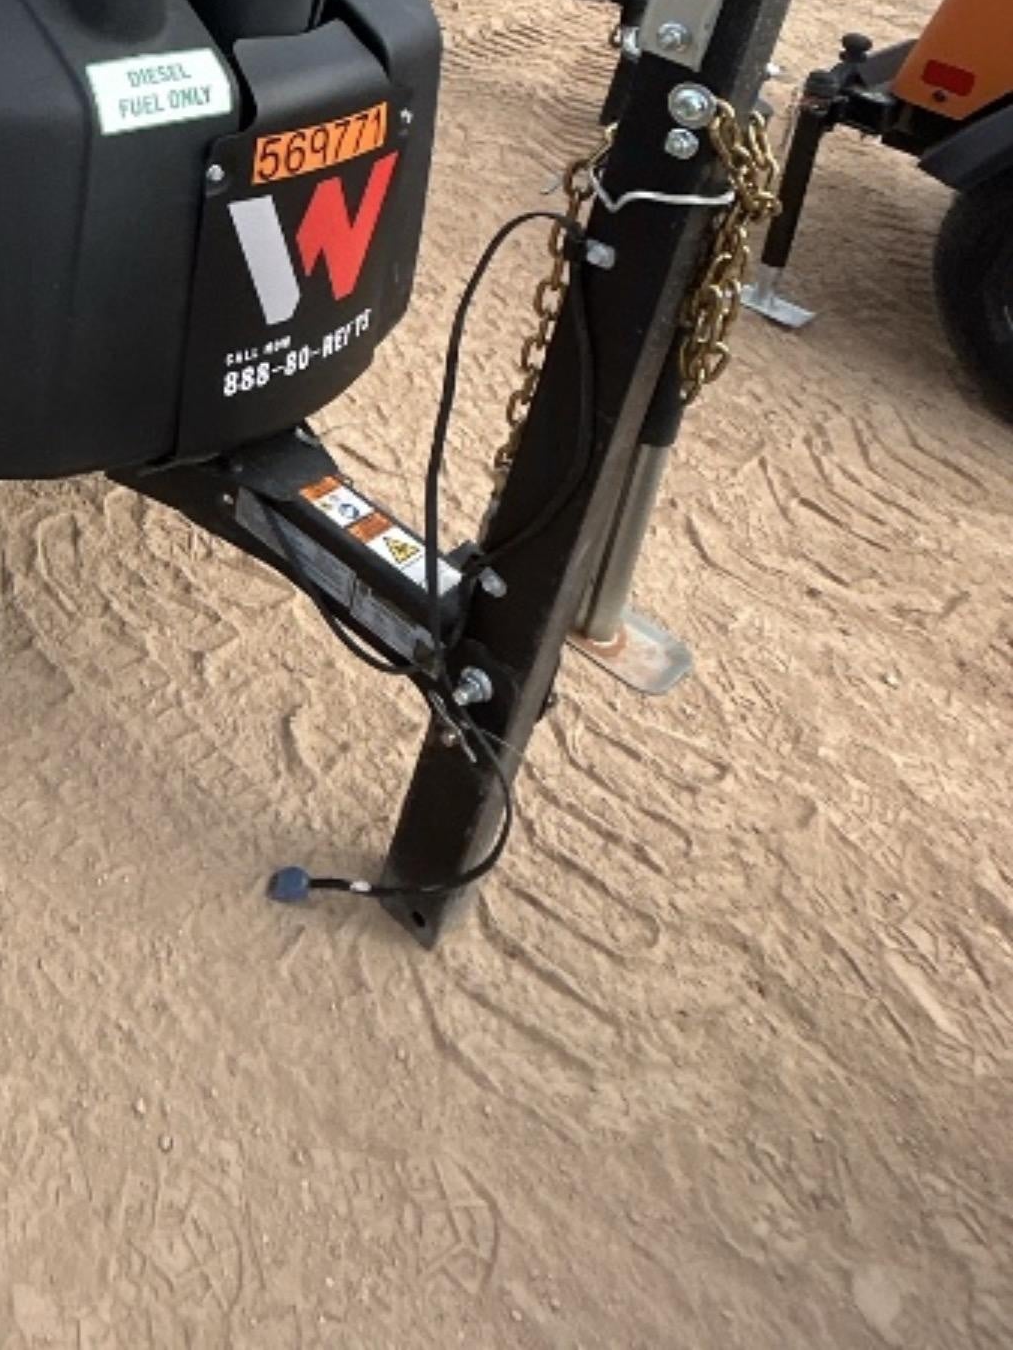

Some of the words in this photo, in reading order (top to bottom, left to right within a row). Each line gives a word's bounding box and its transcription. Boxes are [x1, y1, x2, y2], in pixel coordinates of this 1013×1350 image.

[126, 62, 193, 88] DIESEL
[118, 92, 166, 120] FUEL
[167, 84, 213, 110] ONLY
[257, 107, 382, 181] 569771
